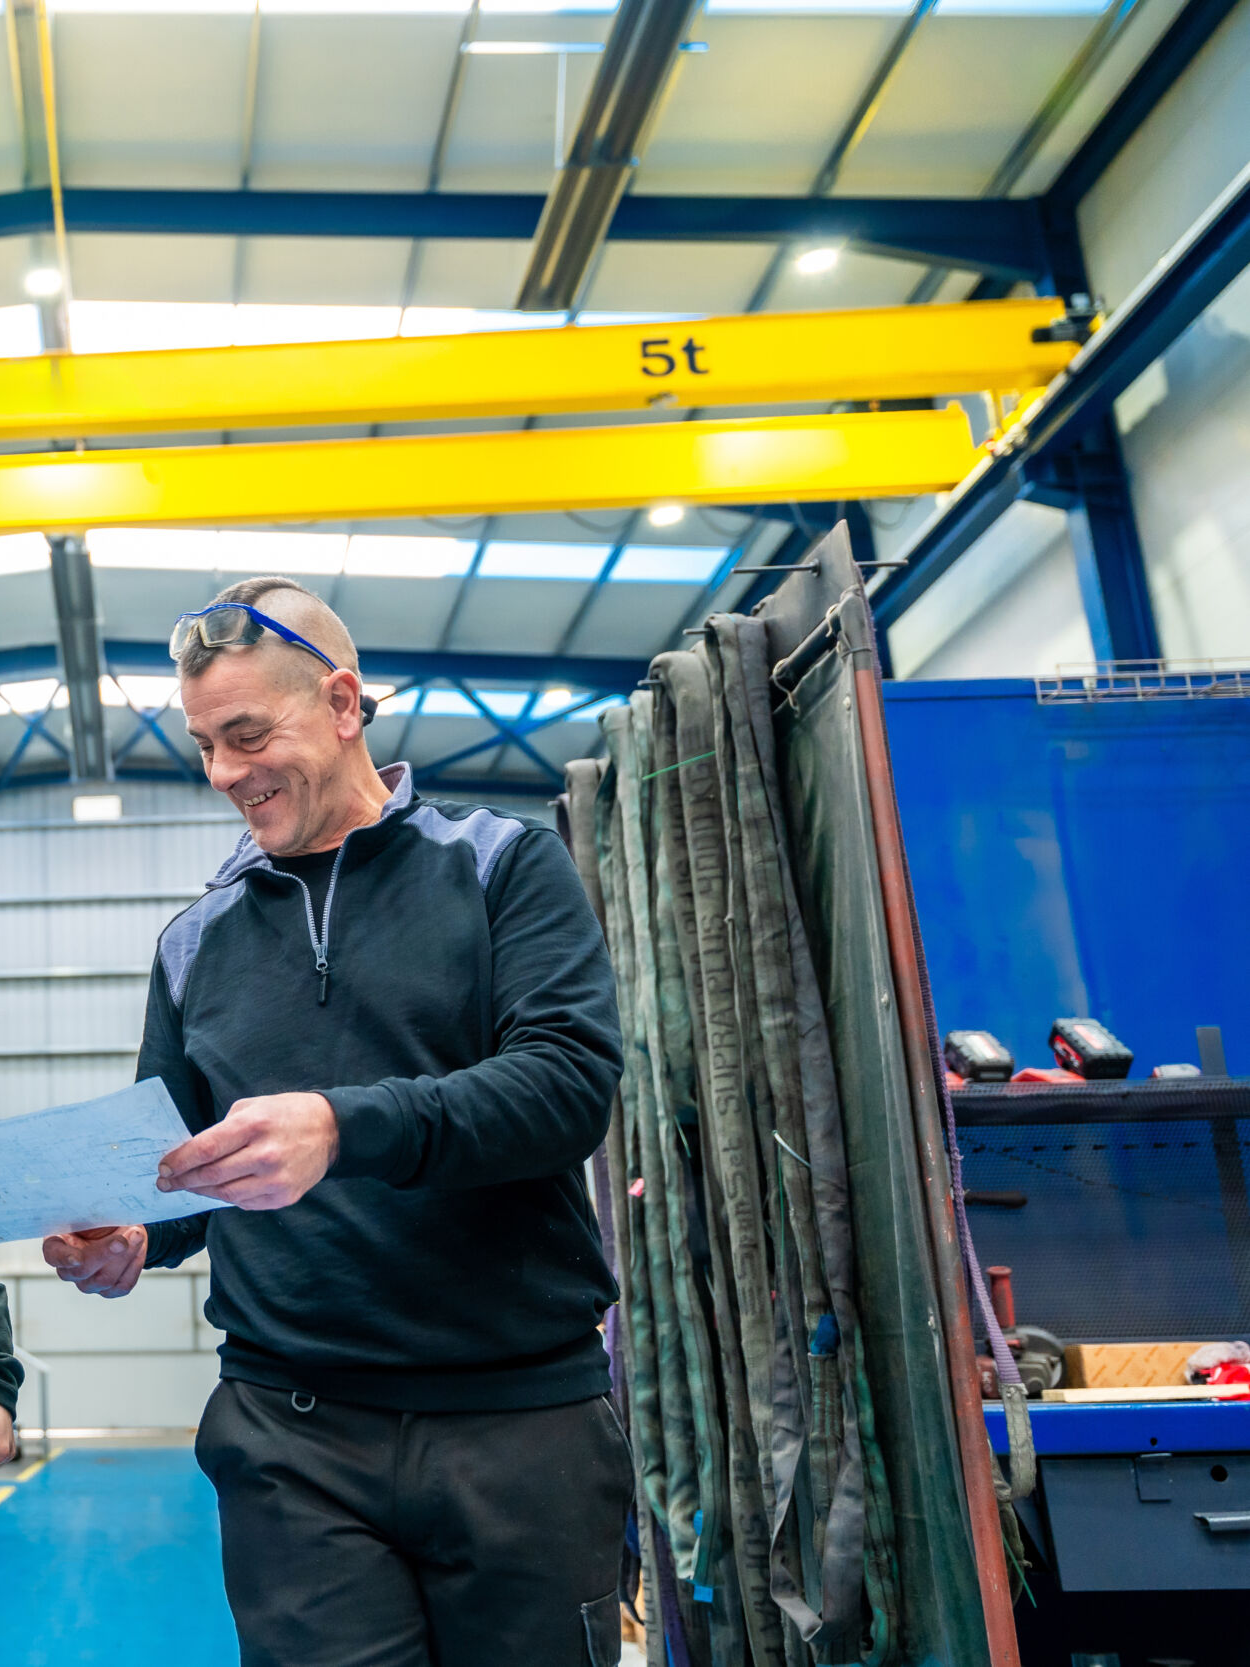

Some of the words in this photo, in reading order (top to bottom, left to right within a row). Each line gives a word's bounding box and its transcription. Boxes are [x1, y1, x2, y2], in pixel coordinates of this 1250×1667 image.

[641, 337, 709, 377] 5t
[686, 762, 716, 805] KG
[690, 815, 723, 895] 4000
[701, 914, 732, 993] PLUS
[709, 1007, 742, 1117] SUPRA
[722, 1136, 759, 1282] SpanSet
